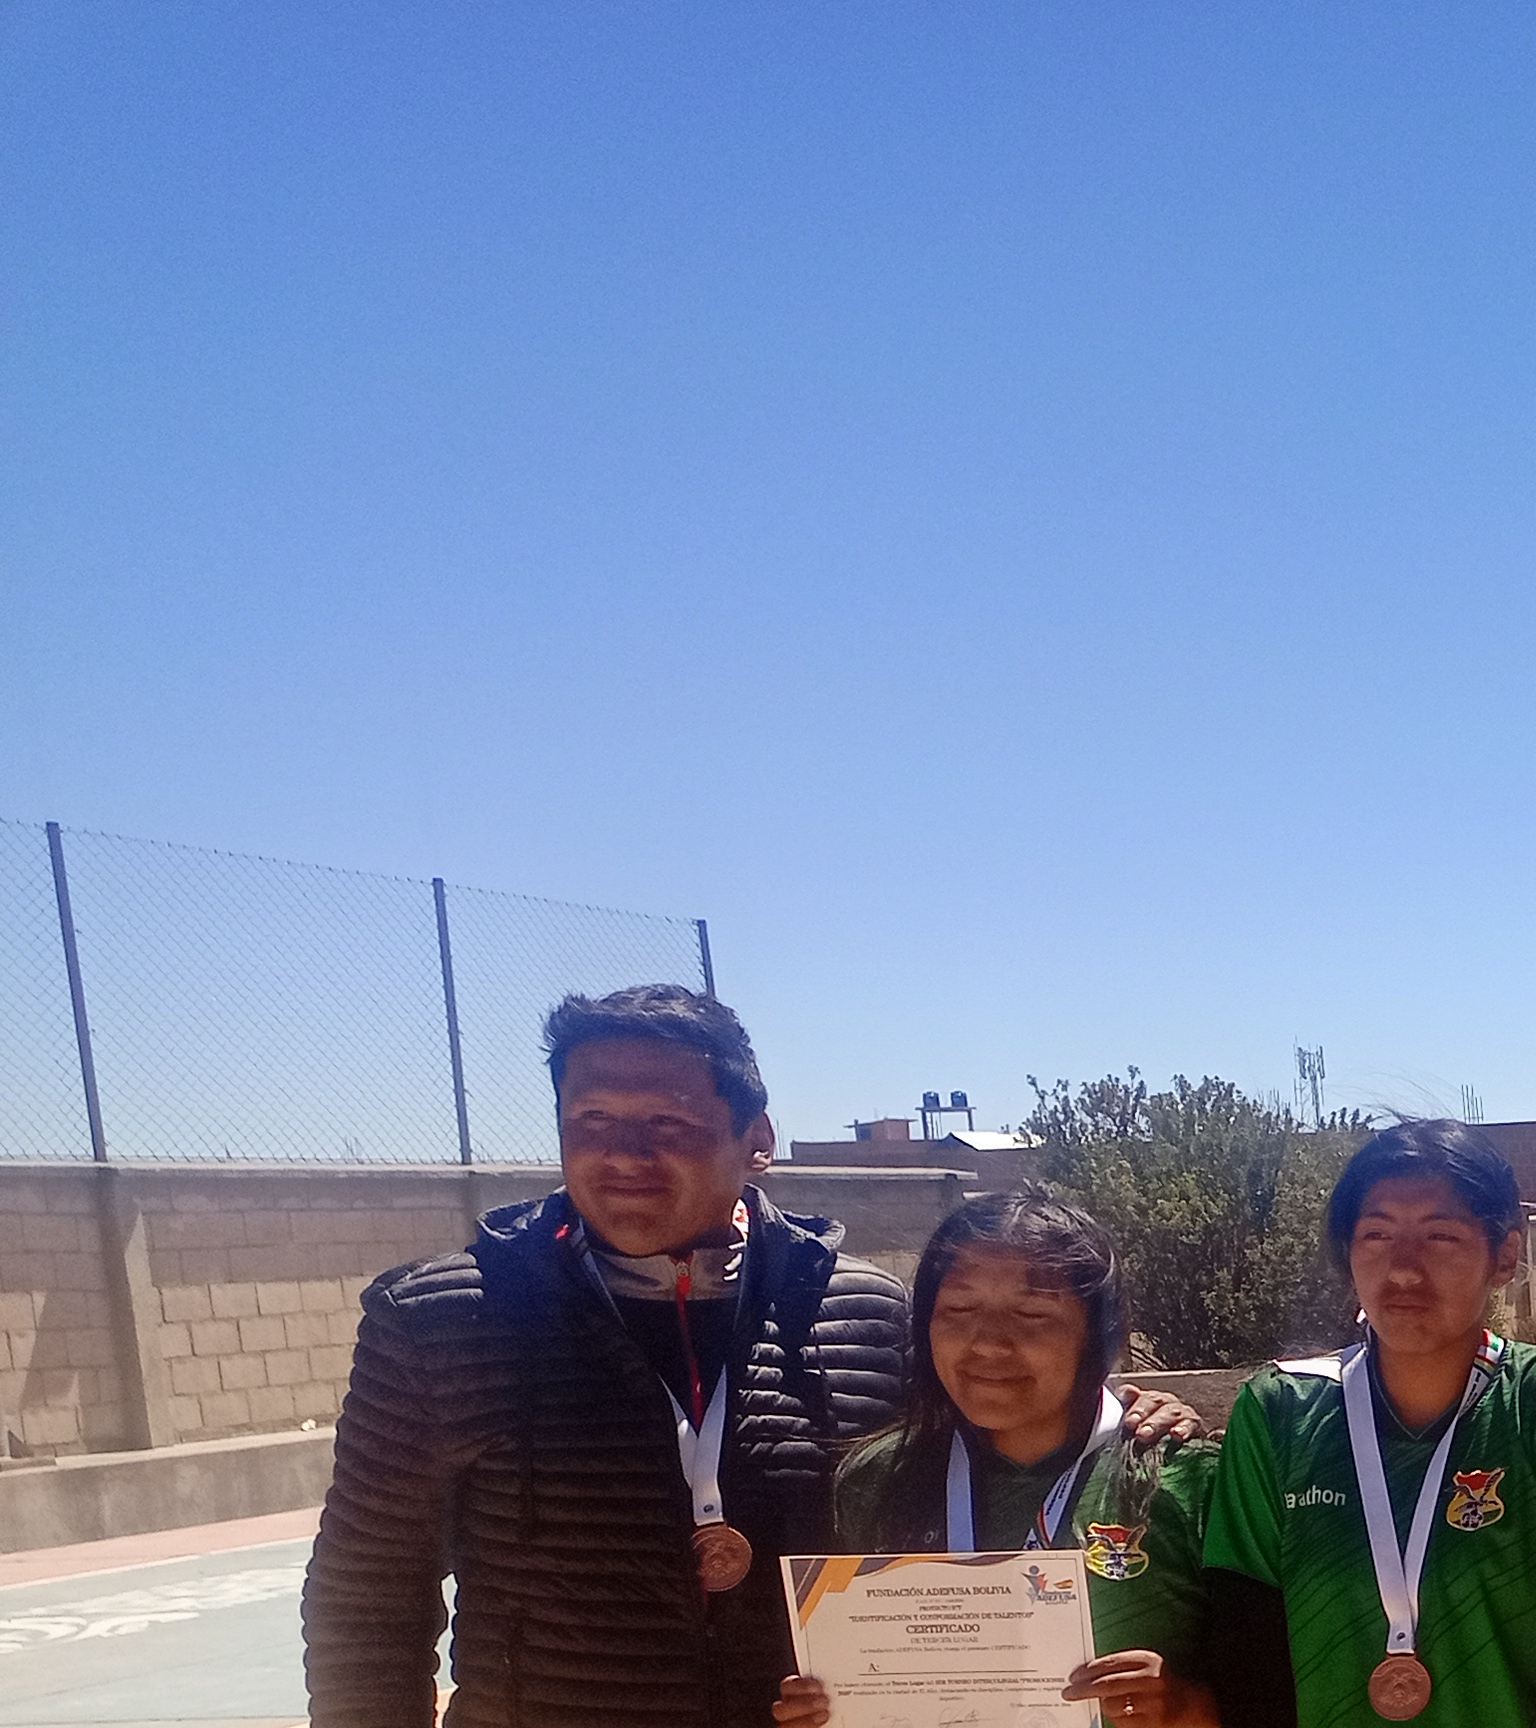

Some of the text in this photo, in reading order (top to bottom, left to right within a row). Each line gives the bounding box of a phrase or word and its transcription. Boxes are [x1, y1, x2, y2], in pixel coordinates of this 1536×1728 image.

[865, 1585, 1012, 1598] FUNDACIÓN ADEFUSA BOLIVIA
[904, 1623, 981, 1634] CERTIFICADO
